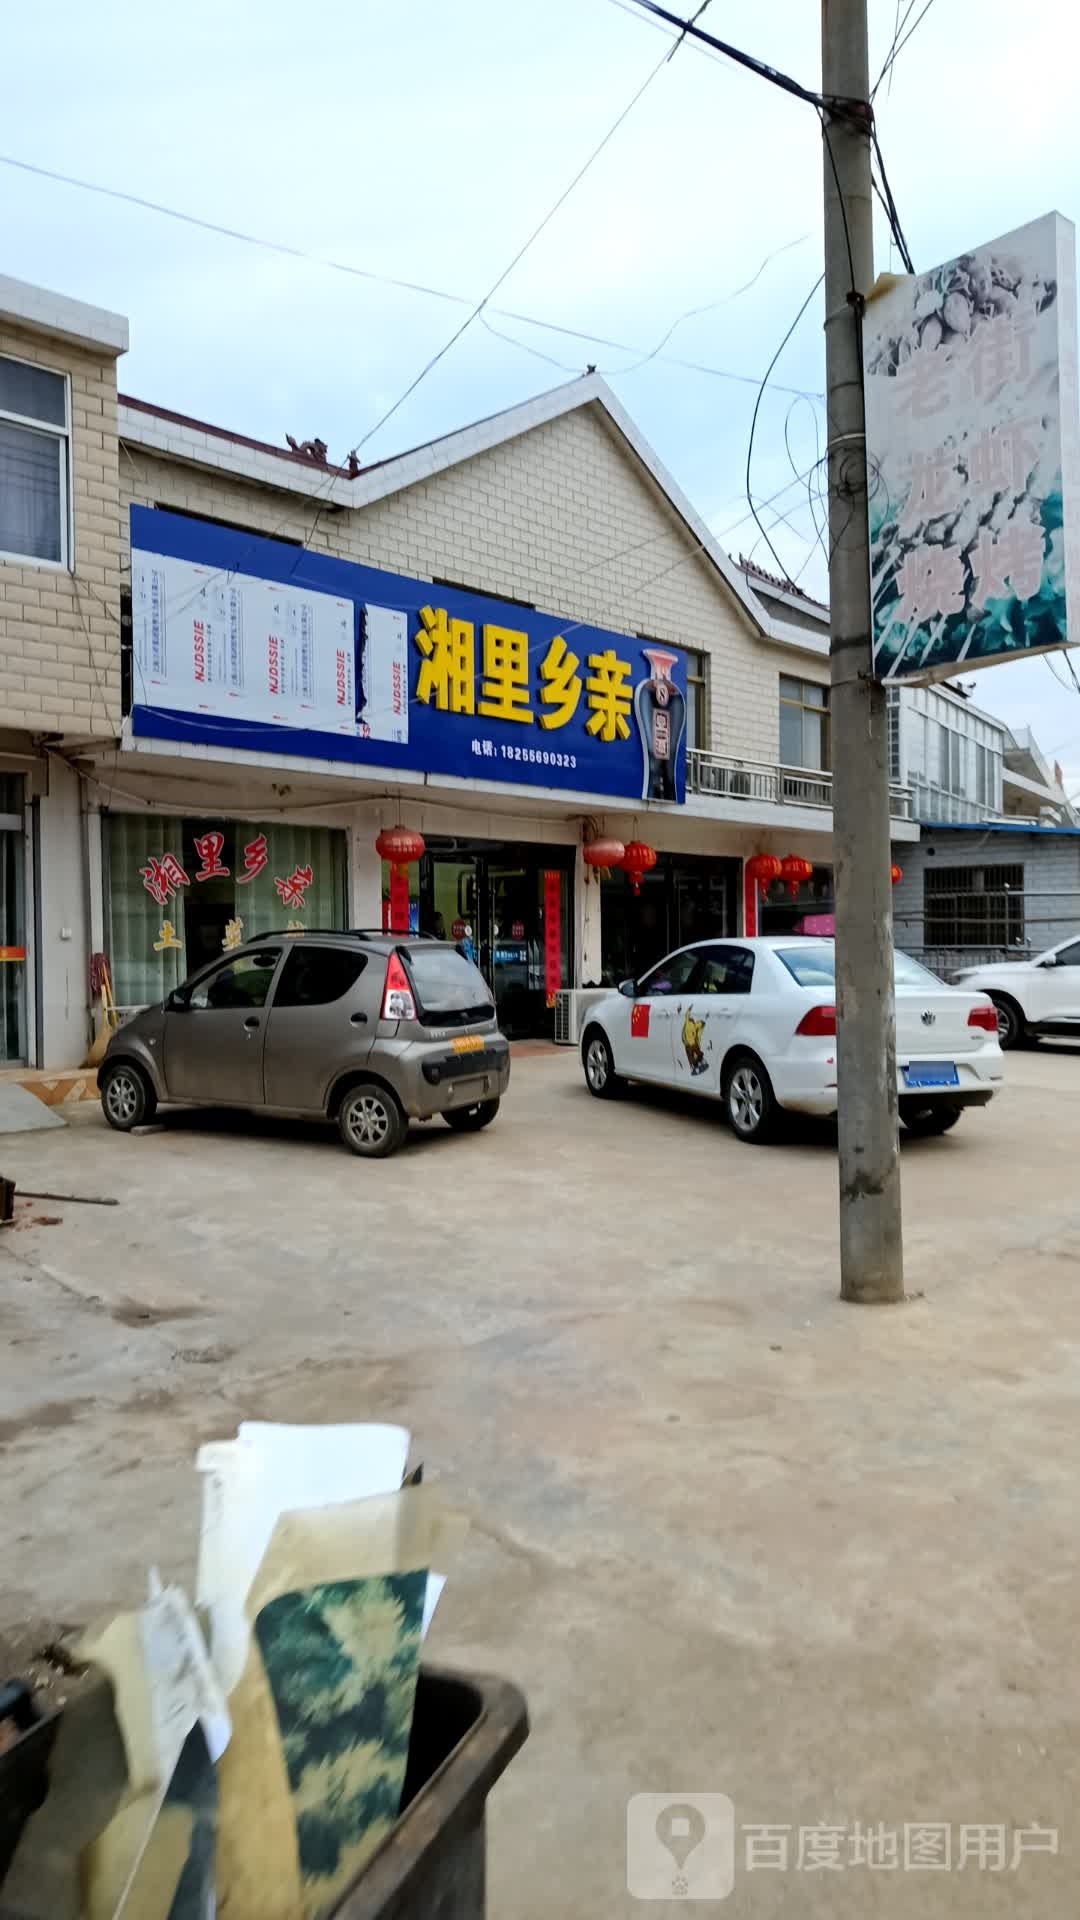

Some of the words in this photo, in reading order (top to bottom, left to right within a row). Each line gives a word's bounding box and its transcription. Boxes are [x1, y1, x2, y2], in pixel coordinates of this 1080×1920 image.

[892, 524, 1046, 624] 烧烤
[414, 604, 633, 743] 湘里乡亲
